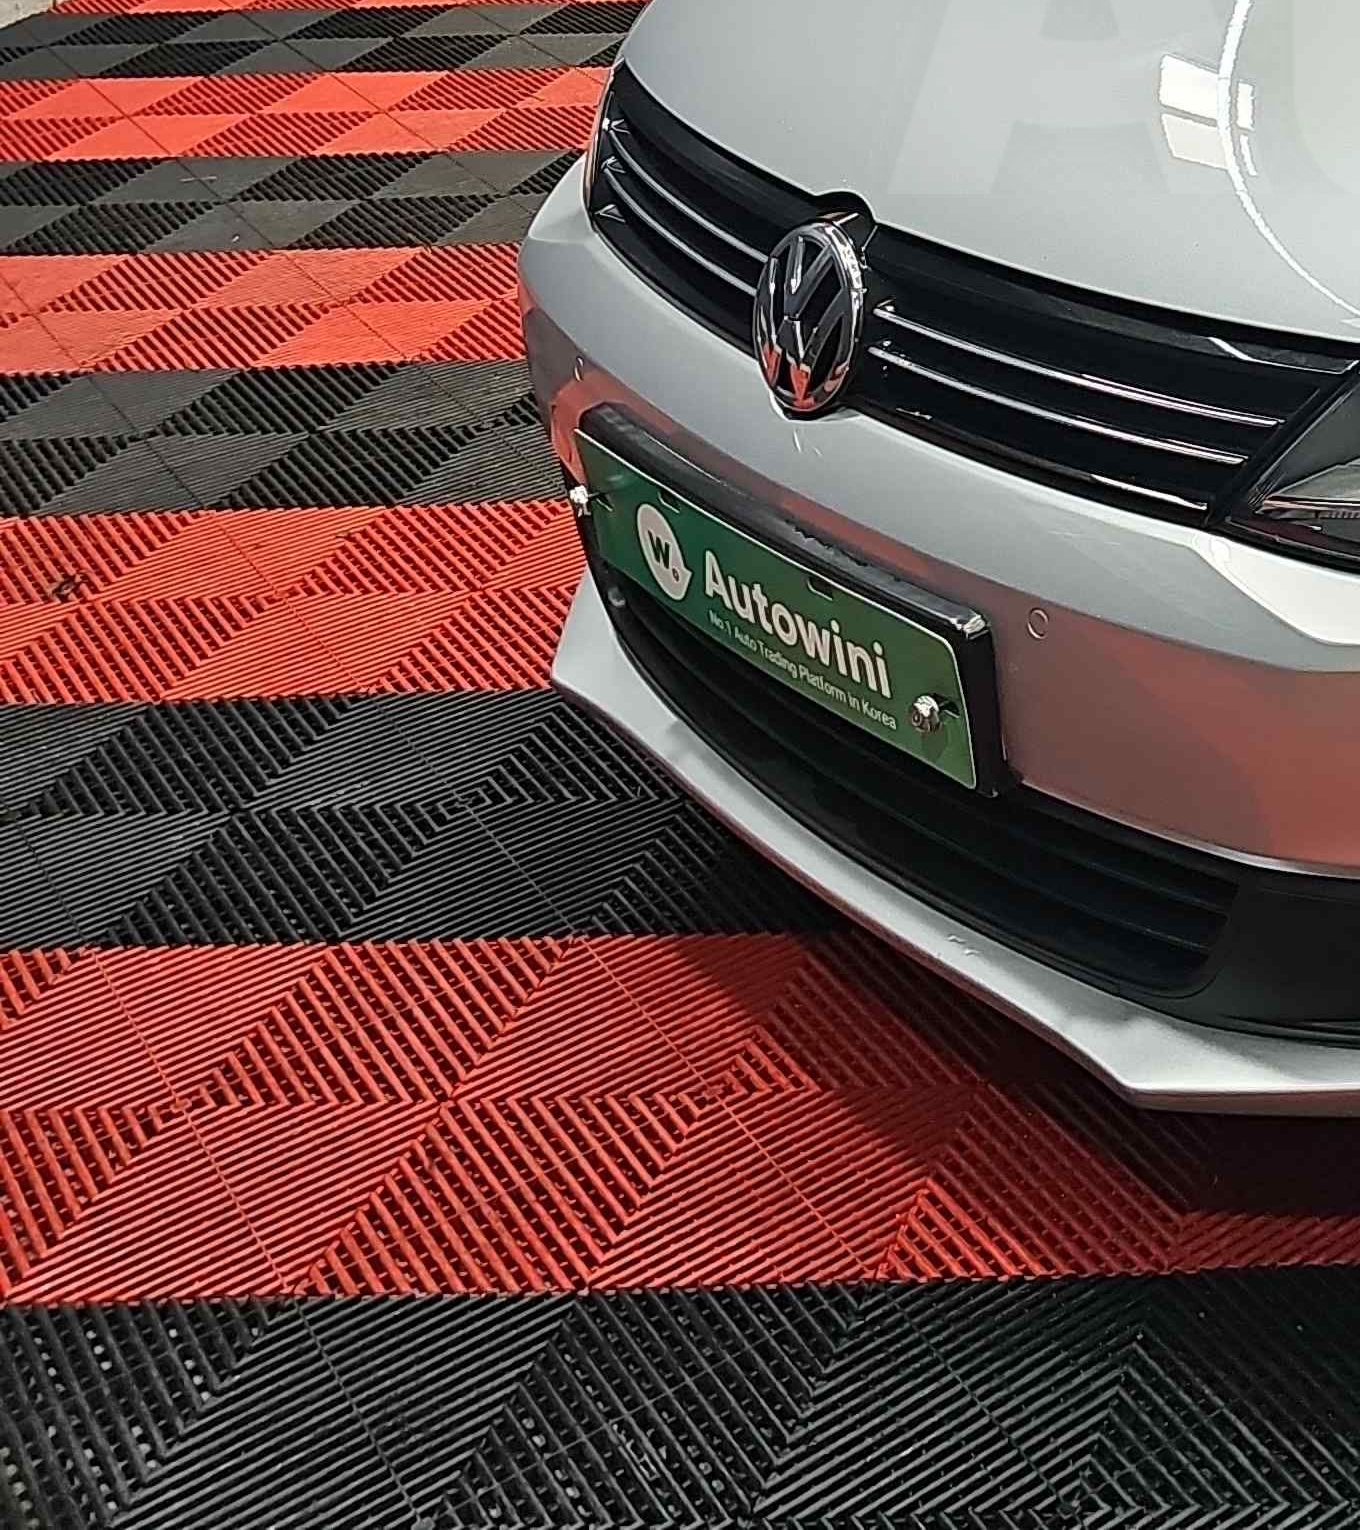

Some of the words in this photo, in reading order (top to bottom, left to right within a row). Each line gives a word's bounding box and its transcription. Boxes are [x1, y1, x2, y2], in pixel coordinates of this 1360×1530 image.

[705, 550, 892, 699] Autowini
[735, 626, 757, 652] Auto
[757, 639, 797, 678] Trading
[799, 664, 847, 703] Platform
[848, 691, 861, 710] in
[861, 699, 896, 729] Korea
